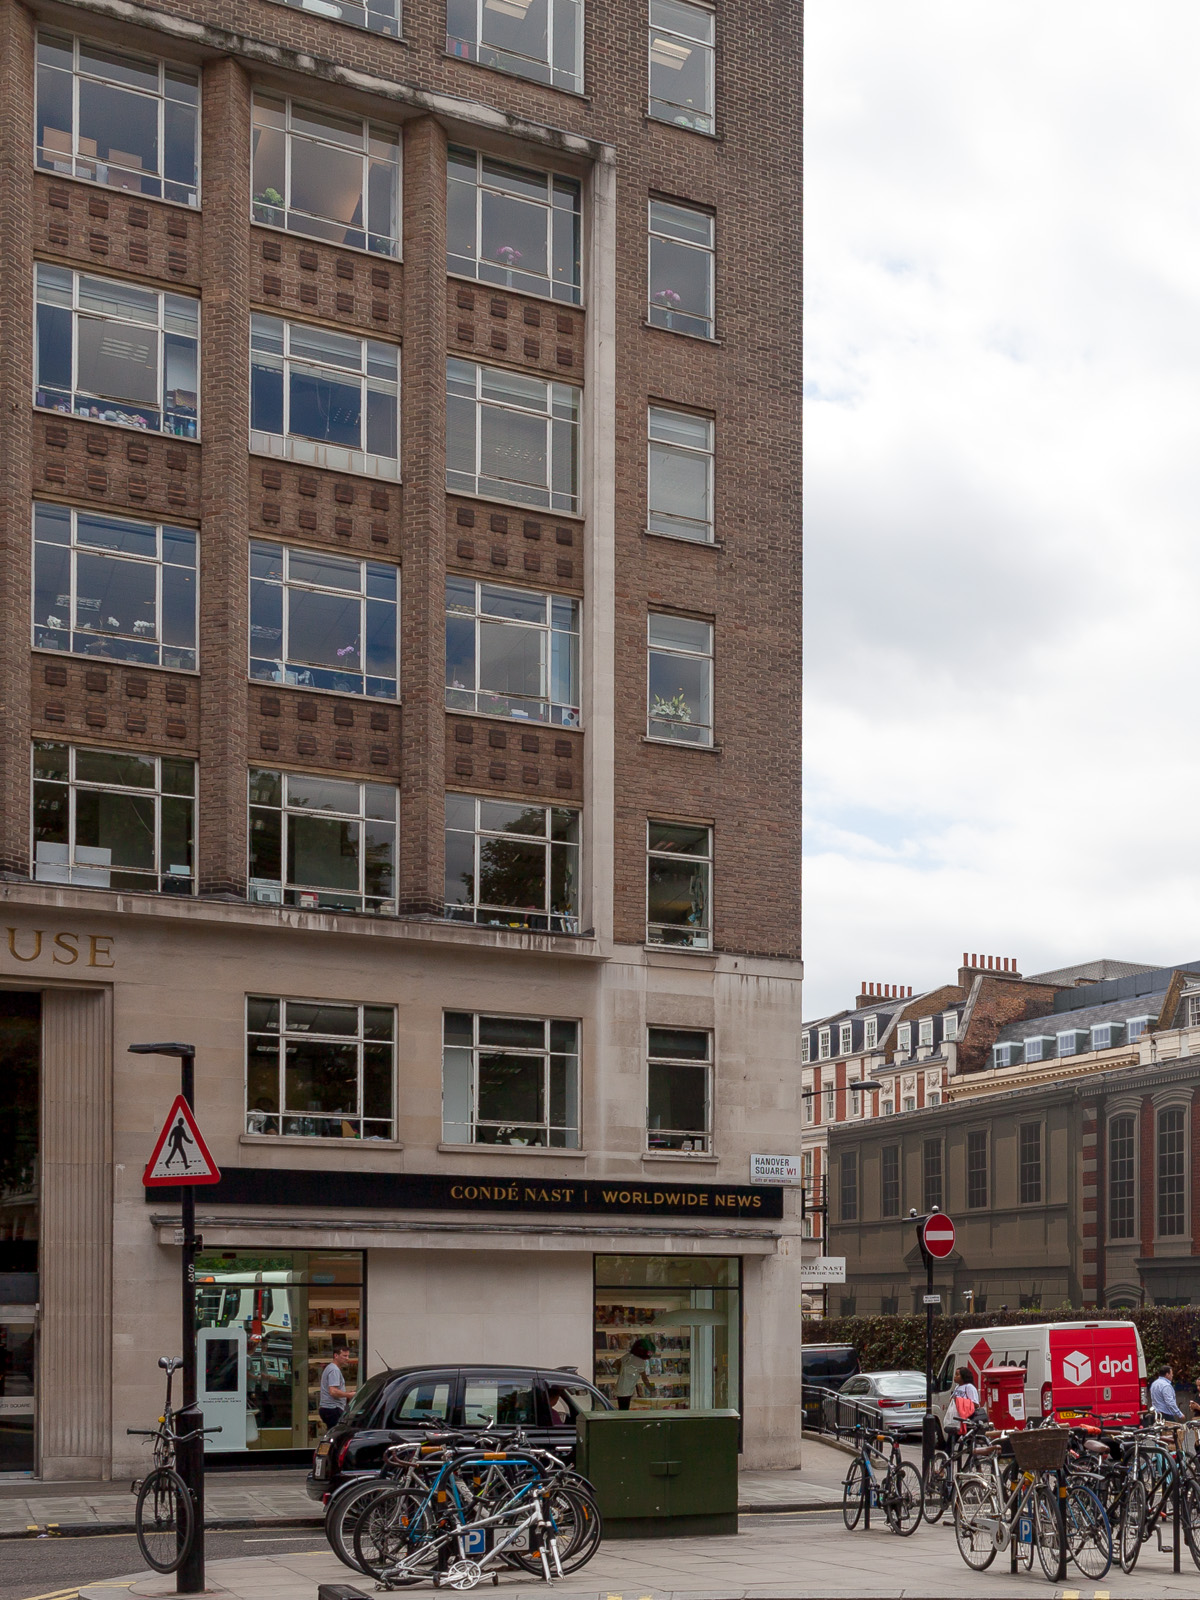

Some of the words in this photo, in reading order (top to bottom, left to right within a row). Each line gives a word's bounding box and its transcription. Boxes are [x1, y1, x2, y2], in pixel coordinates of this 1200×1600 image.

[5, 926, 117, 968] USE
[755, 1157, 790, 1167] HANOVER
[755, 1166, 785, 1176] SQUARE
[786, 1167, 797, 1176] W1
[450, 1182, 519, 1201] CONDÉ
[524, 1188, 575, 1203] NAST
[602, 1190, 709, 1207] WORLDWIDE
[715, 1194, 762, 1208] NEWS
[1098, 1354, 1133, 1378] dpd
[1022, 1520, 1030, 1540] P
[465, 1531, 482, 1552] P
